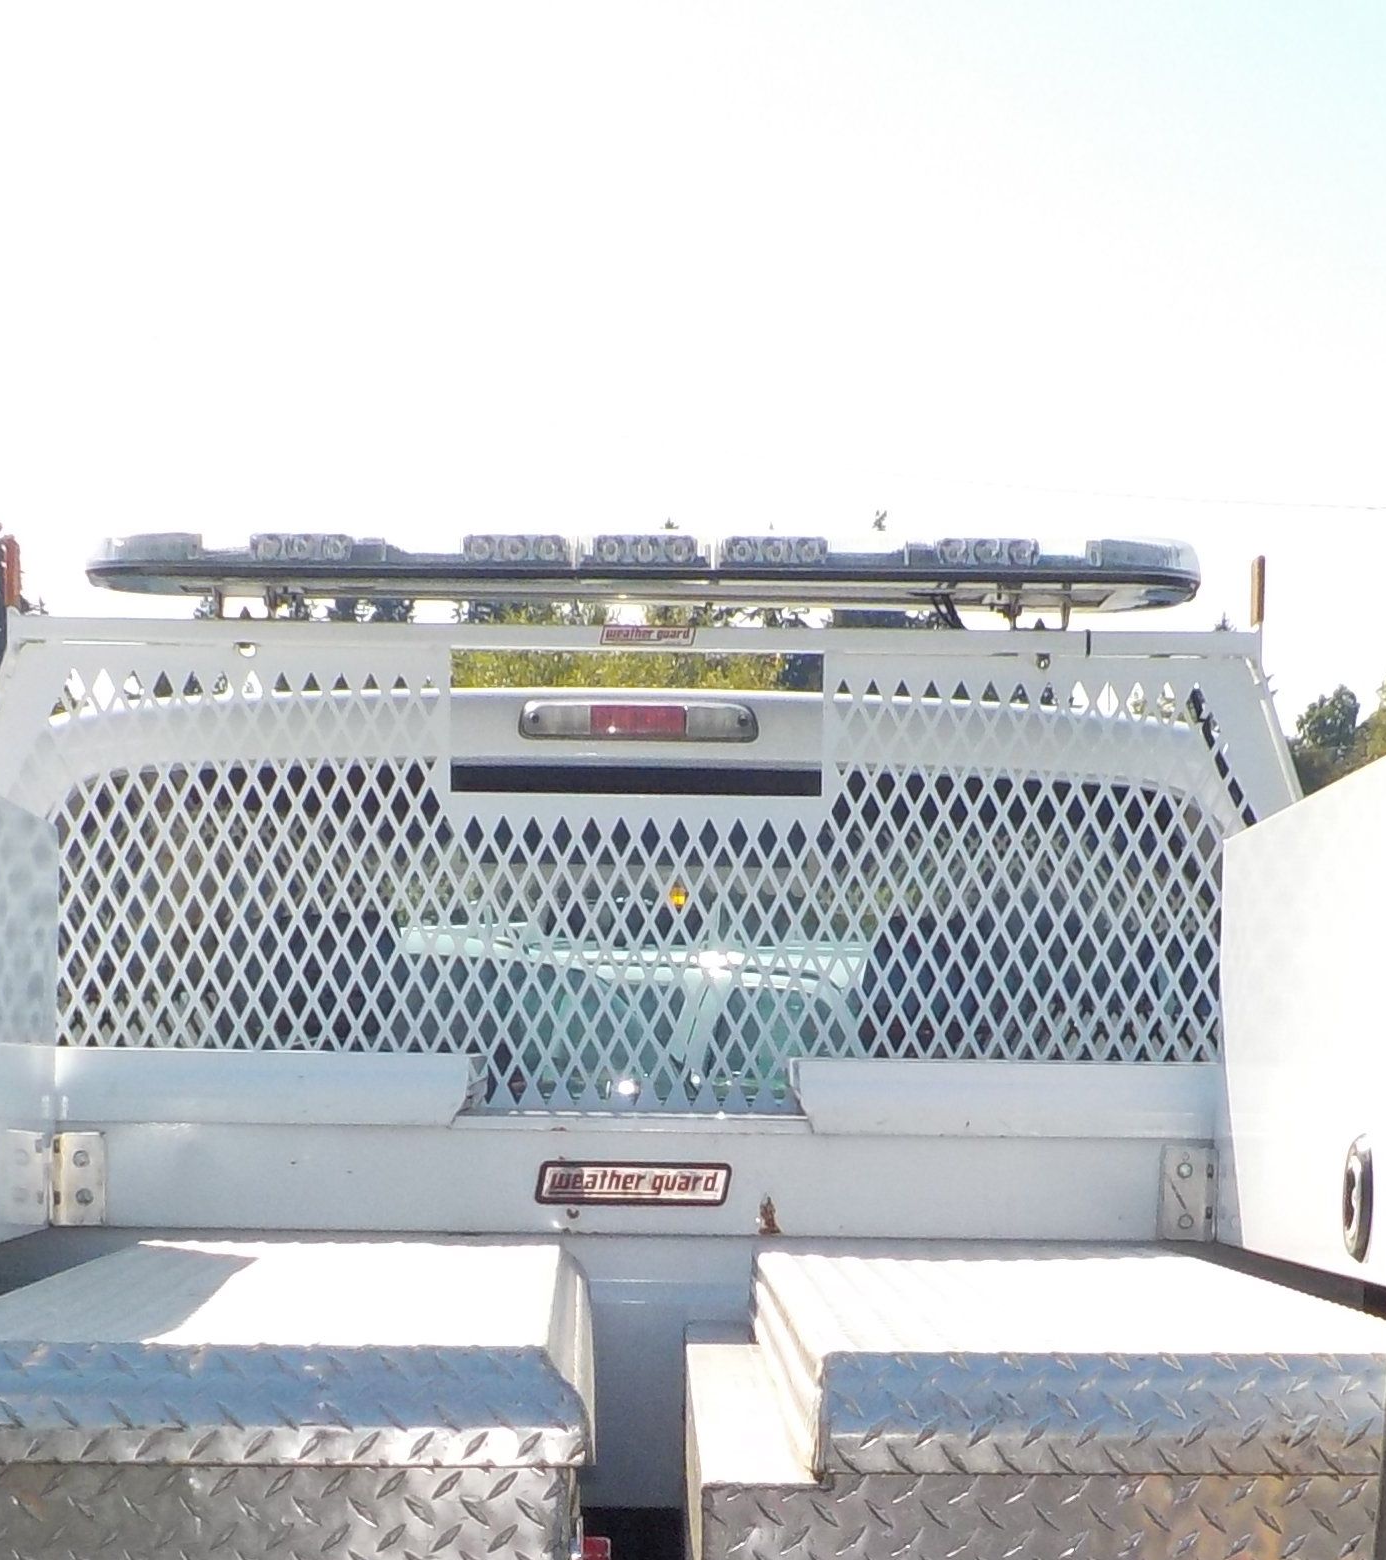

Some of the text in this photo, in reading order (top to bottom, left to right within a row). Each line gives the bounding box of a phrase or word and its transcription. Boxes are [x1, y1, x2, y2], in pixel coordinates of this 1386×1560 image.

[606, 626, 690, 640] weather guard
[550, 1170, 718, 1195] weather guard
